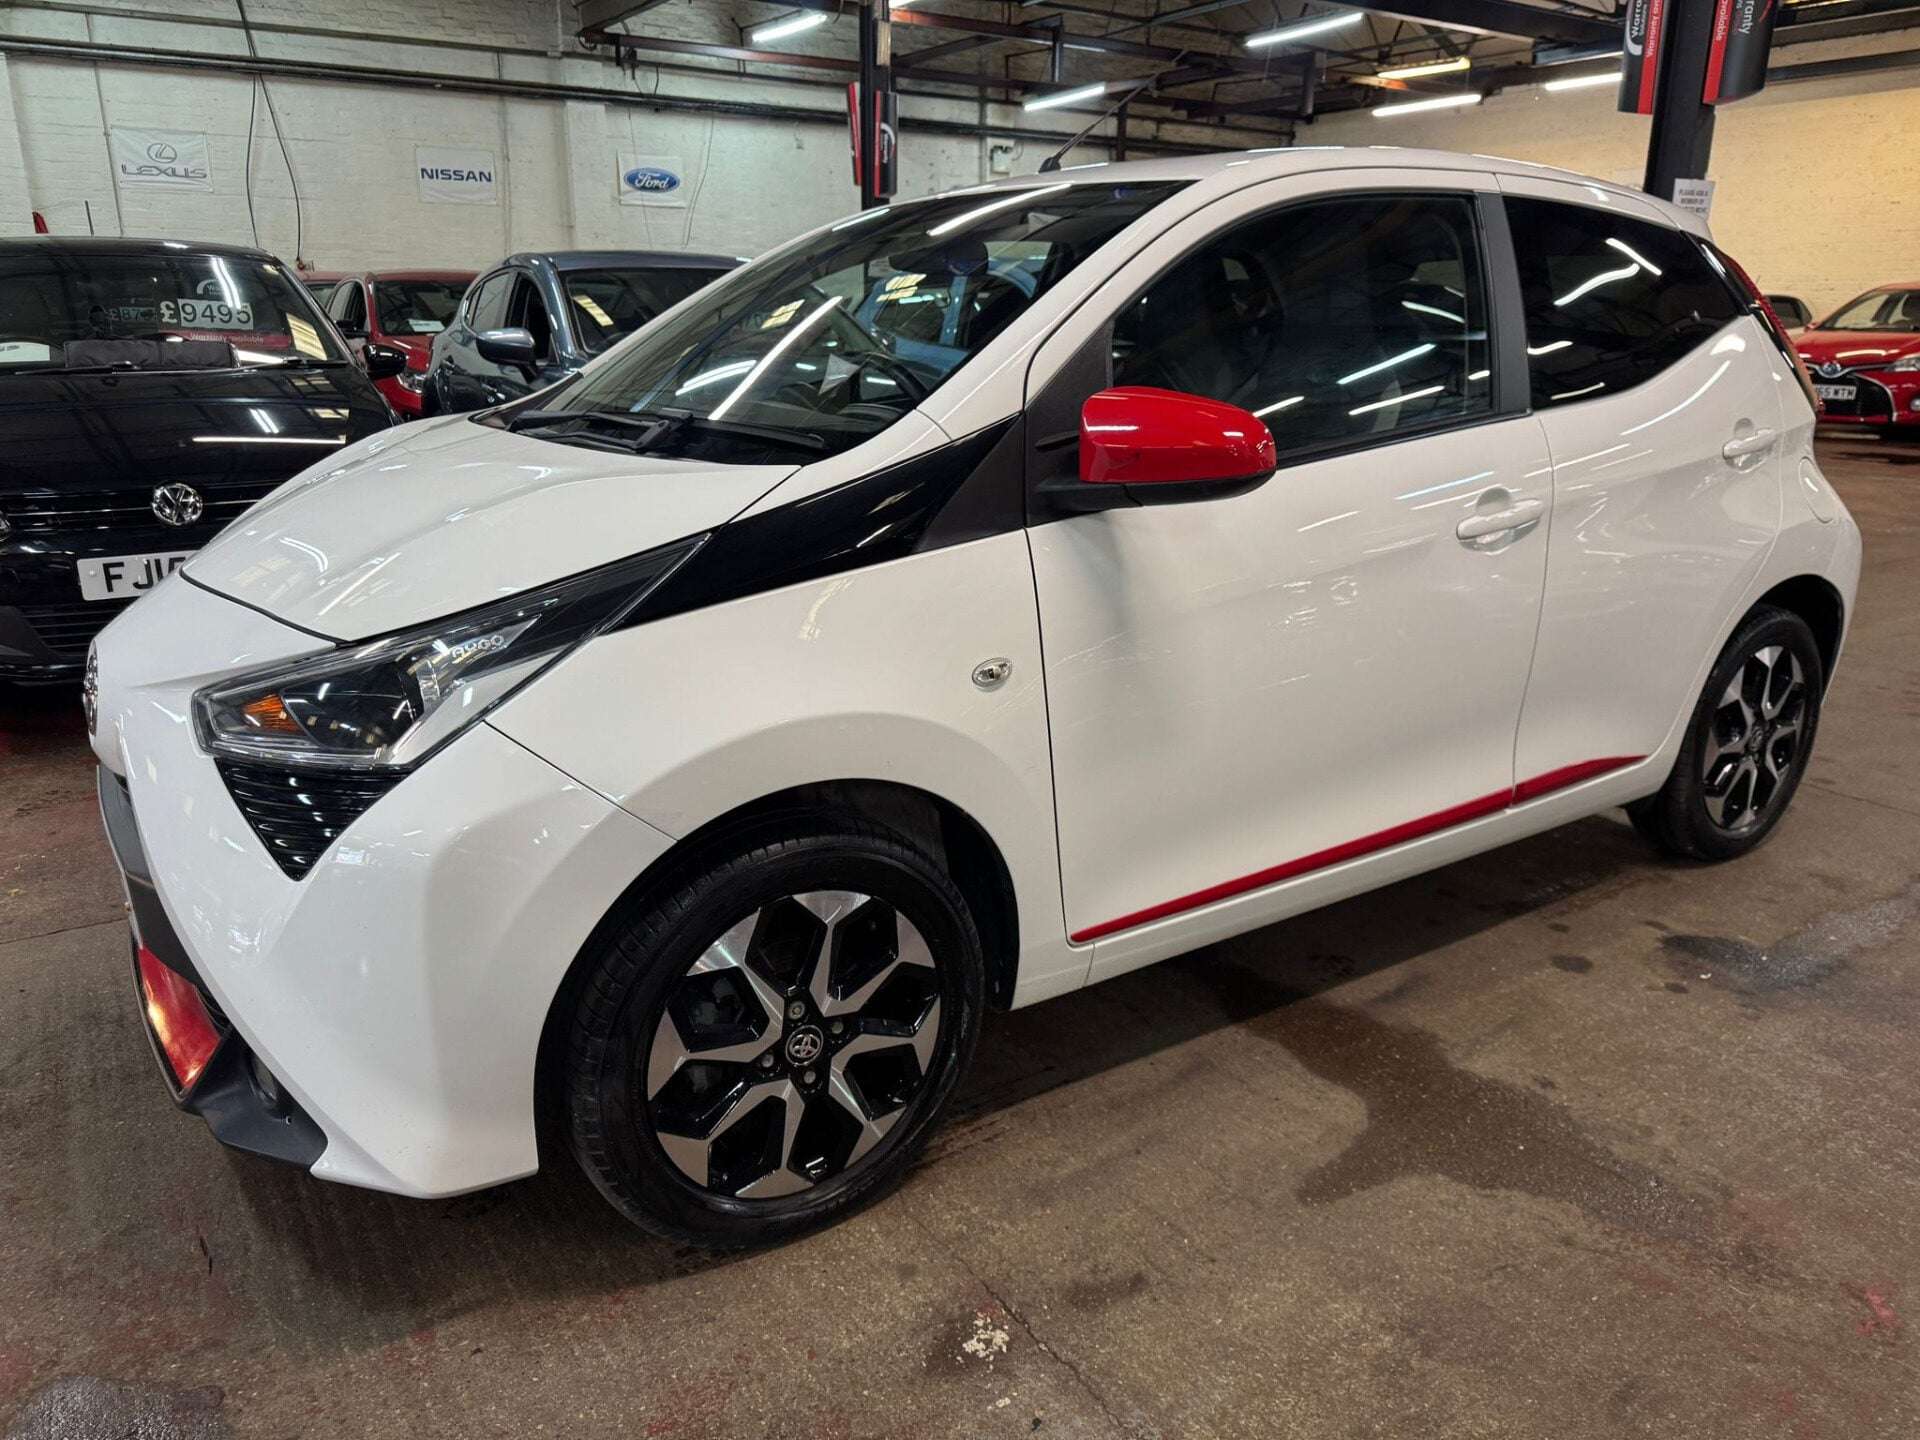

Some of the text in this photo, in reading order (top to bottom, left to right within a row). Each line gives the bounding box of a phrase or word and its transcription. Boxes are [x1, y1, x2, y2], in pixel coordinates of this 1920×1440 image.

[121, 164, 207, 179] LEXUS
[420, 167, 492, 182] NISSAN
[634, 171, 670, 189] Ford
[191, 331, 227, 343] Warranty
